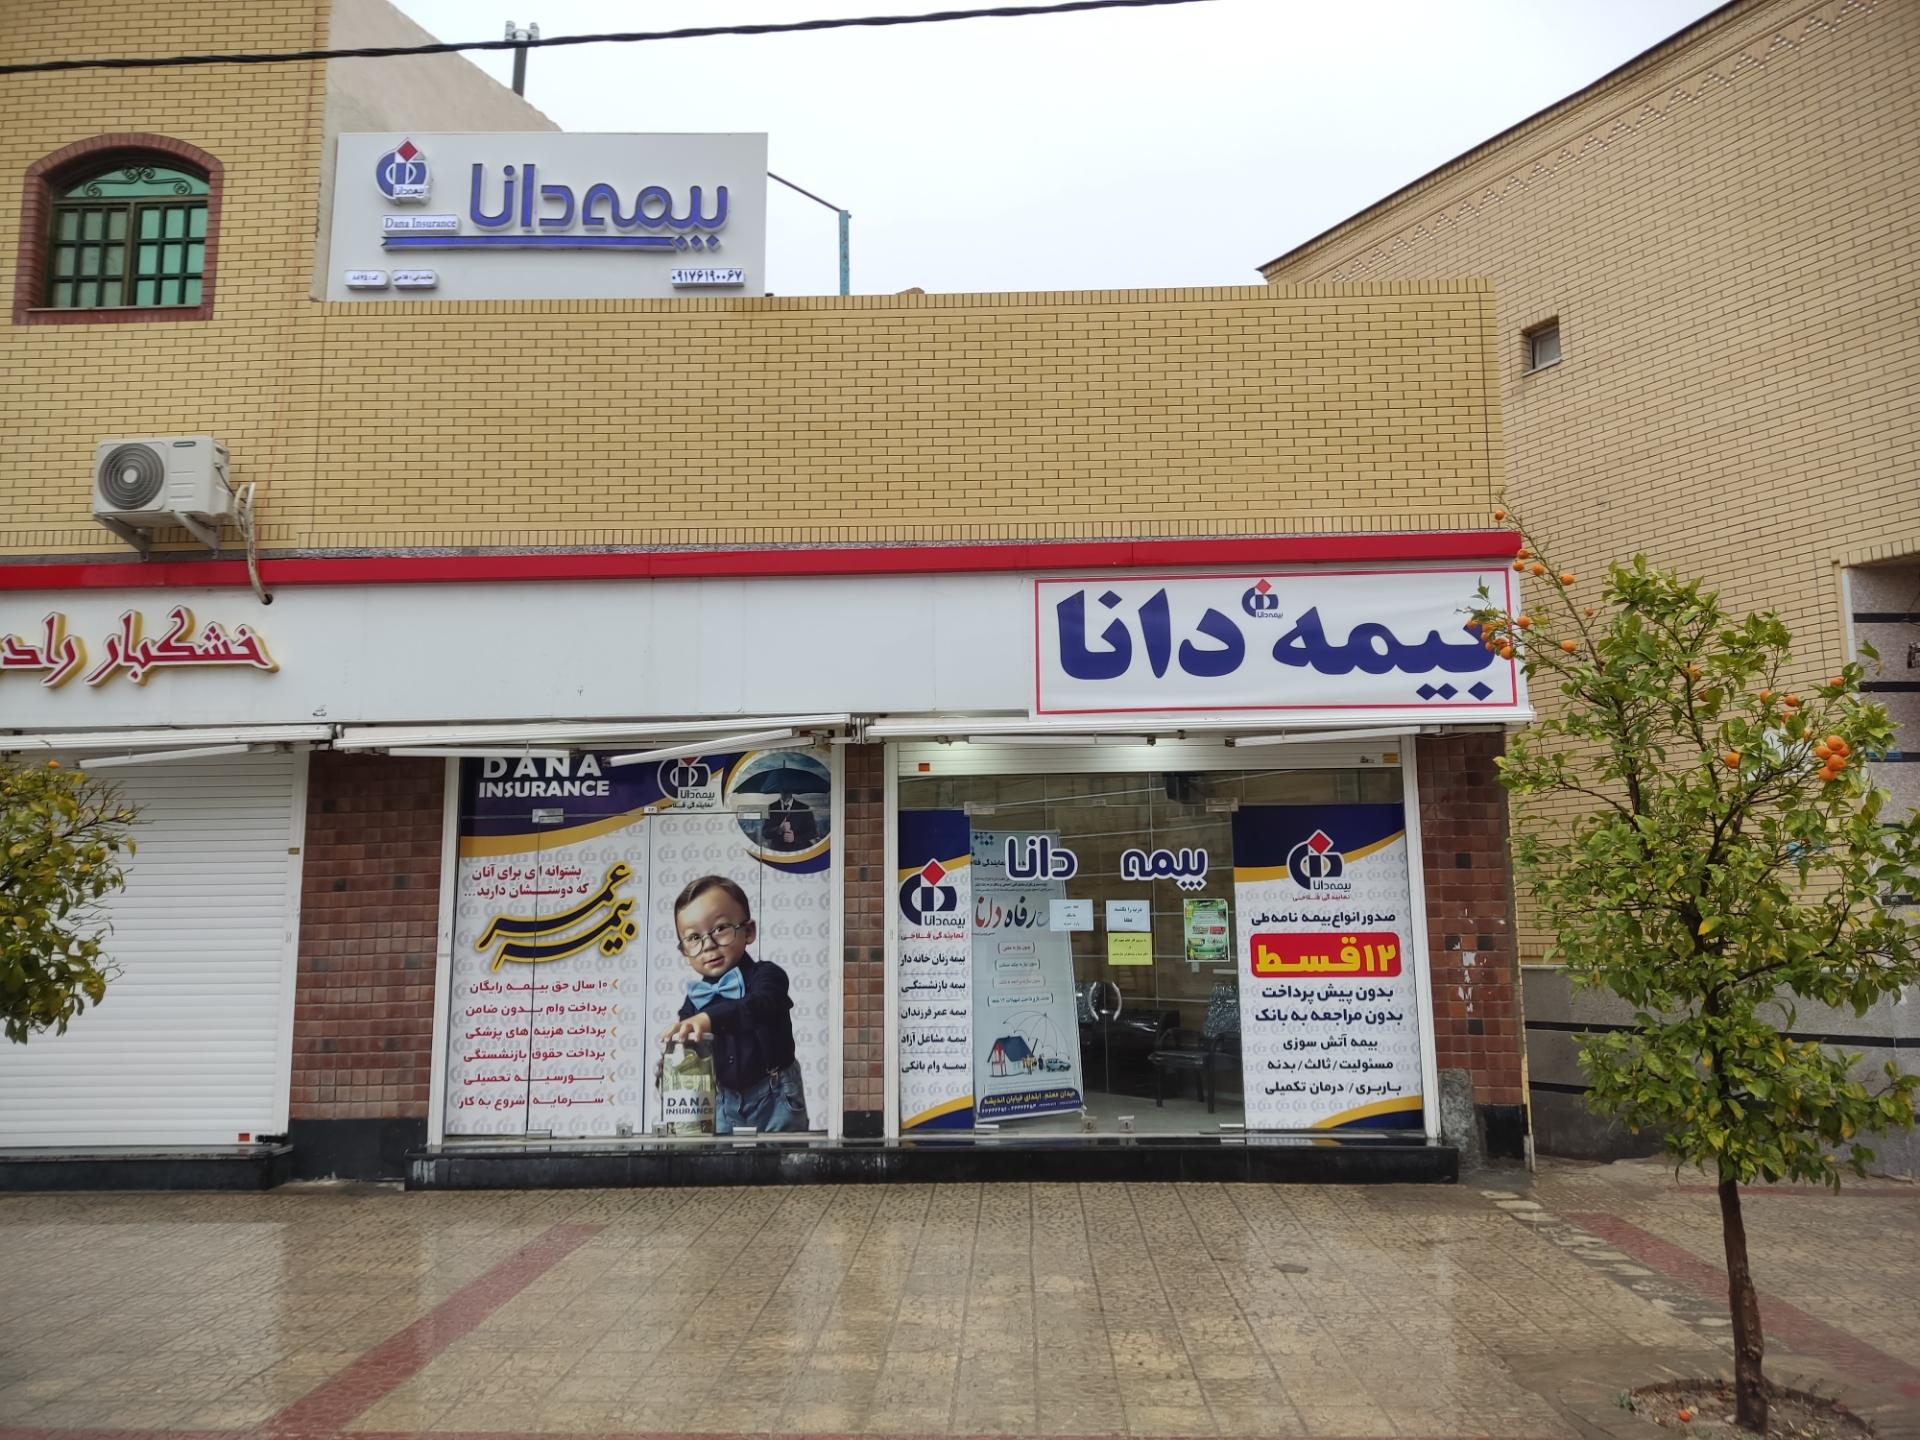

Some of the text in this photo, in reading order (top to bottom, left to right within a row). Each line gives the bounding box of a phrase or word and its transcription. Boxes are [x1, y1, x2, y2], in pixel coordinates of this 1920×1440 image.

[470, 163, 729, 250] بیمه دانا
[384, 217, 457, 229] Dana Insurance
[1056, 587, 1497, 701] بیمه دانا
[483, 754, 602, 779] DANA
[479, 780, 610, 798] INSURANCE
[1006, 835, 1207, 890] بیمه دانا
[472, 864, 495, 881] آنان
[497, 866, 521, 881] برای
[545, 865, 582, 880] پشتوانه
[509, 883, 573, 899] دوستشان
[576, 883, 589, 895] که
[1251, 912, 1396, 928] صدور انواع بیمه نامه طی
[932, 953, 948, 966] زنان
[949, 955, 966, 966] بیمه
[1256, 936, 1397, 973] ۱۲ قسط
[469, 981, 504, 994] رایگان
[506, 980, 550, 992] بیمه
[551, 982, 569, 994] حق
[573, 980, 598, 992] سال
[901, 980, 966, 993] بیمه بازنشستگی
[1262, 983, 1393, 1004] بدون پیش پرداخت
[465, 1003, 607, 1017] پرداخت وام بدون ضامن
[901, 1006, 967, 1020] بیمه عمر فرزندان
[1255, 1008, 1403, 1026] بدون مراجعه به بانک
[465, 1026, 607, 1041] پرداخت هزینه های پزشکی
[901, 1031, 967, 1047] بیمه مشاغل آزاد
[1283, 1034, 1378, 1051] بیمه آتش سوزی
[463, 1048, 606, 1063] پرداخت حقوق بازنشستگی
[901, 1060, 967, 1074] بیمه وام بانکی
[1267, 1060, 1296, 1074] بدنه
[463, 1071, 511, 1086] تحصیلی
[1265, 1081, 1306, 1096] تکمیلی
[1309, 1081, 1344, 1096] درمان
[459, 1094, 605, 1111] سرمایه شروع به کار
[666, 1097, 712, 1108] DANA
[665, 1106, 715, 1116] INSURANCE
